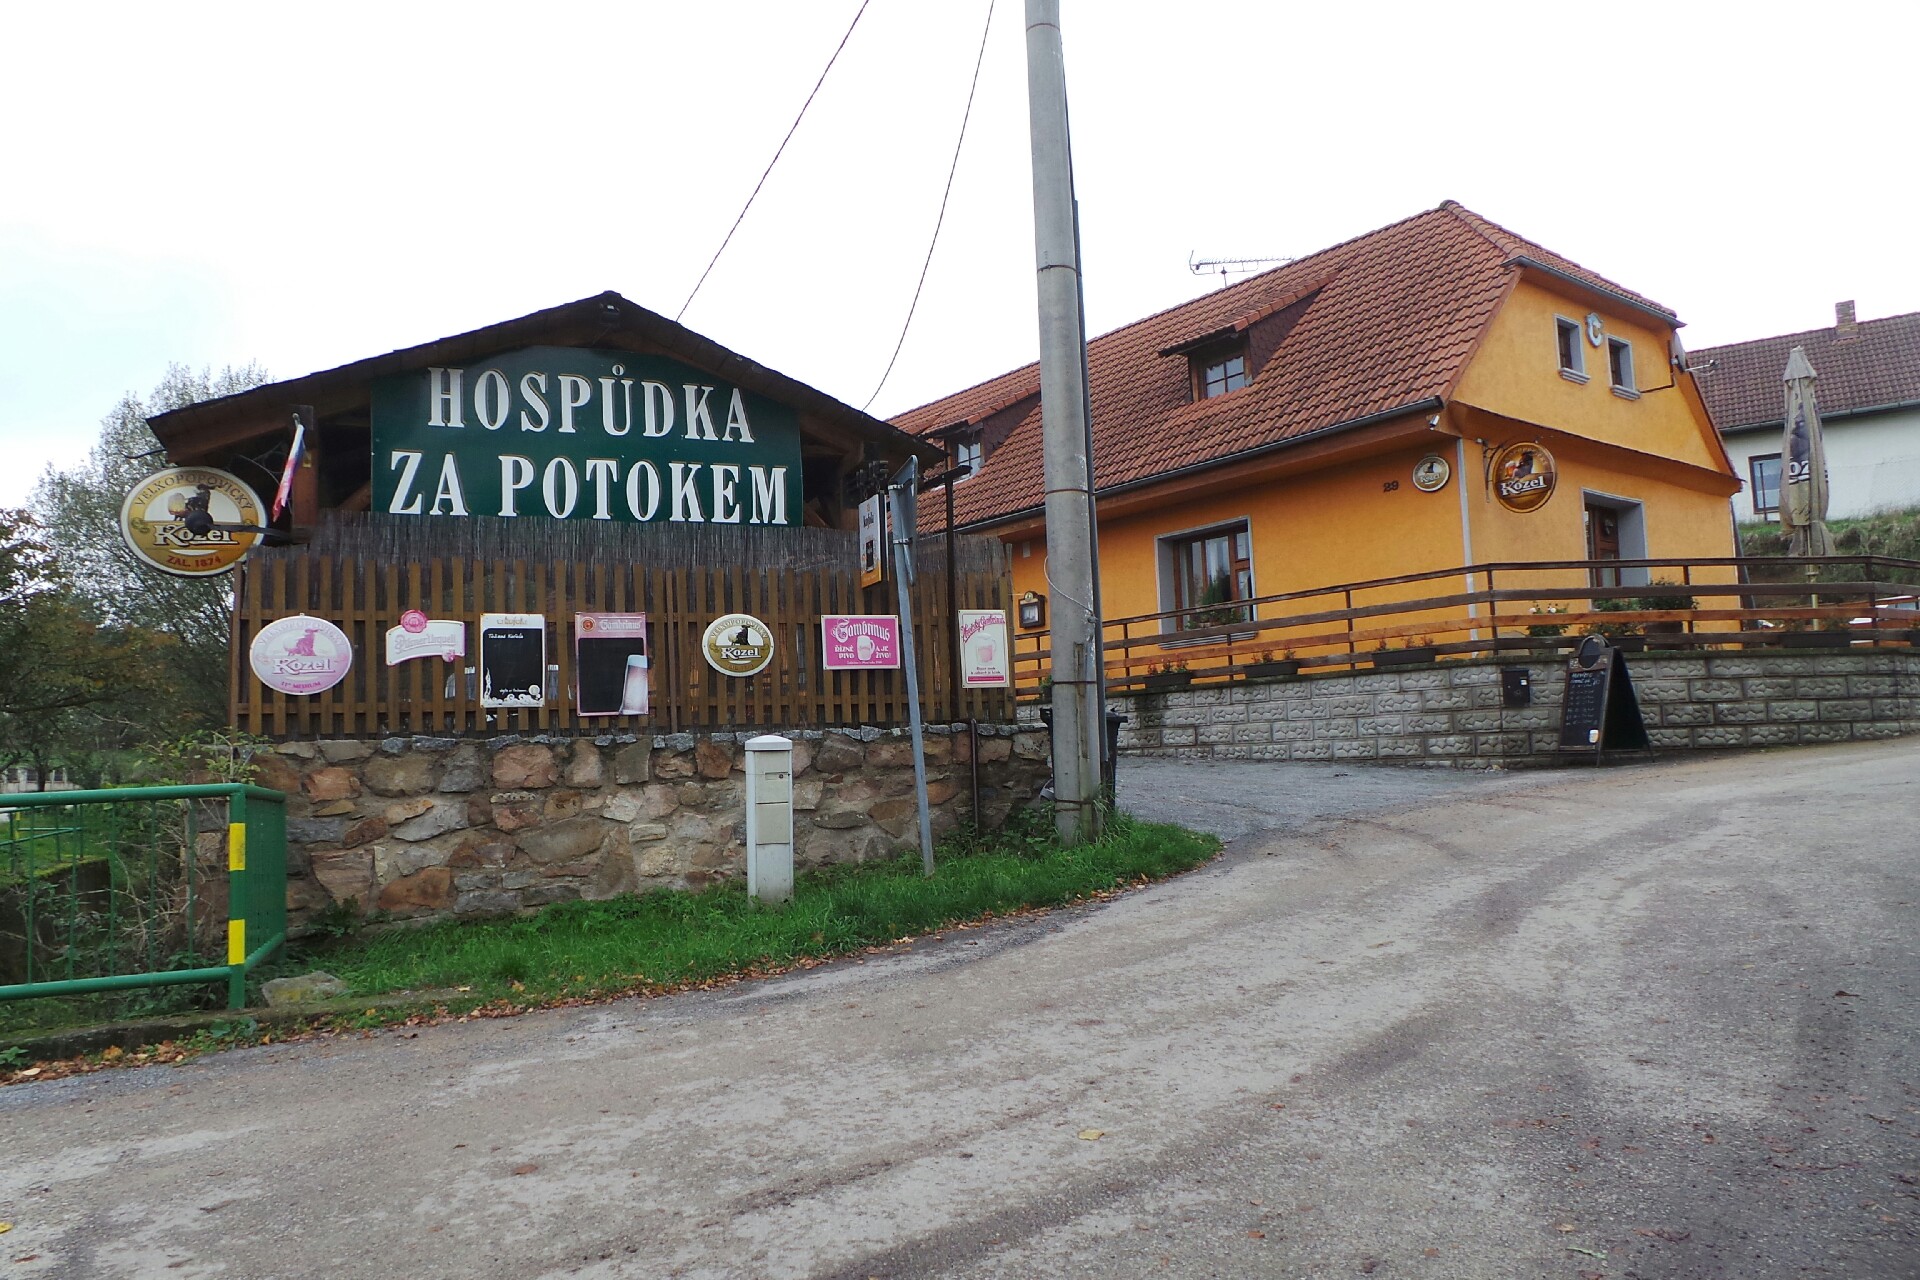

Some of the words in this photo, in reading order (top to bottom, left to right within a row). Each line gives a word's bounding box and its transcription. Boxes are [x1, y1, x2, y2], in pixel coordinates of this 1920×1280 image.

[428, 363, 755, 443] HOSPŮDKA
[389, 450, 469, 516] ZA
[499, 454, 788, 524] POTOKEM
[1501, 475, 1546, 496] Kozel
[195, 555, 221, 568] 1874
[831, 617, 890, 643] Gambrinus
[721, 647, 762, 660] Kozel
[272, 658, 336, 675] Kozel
